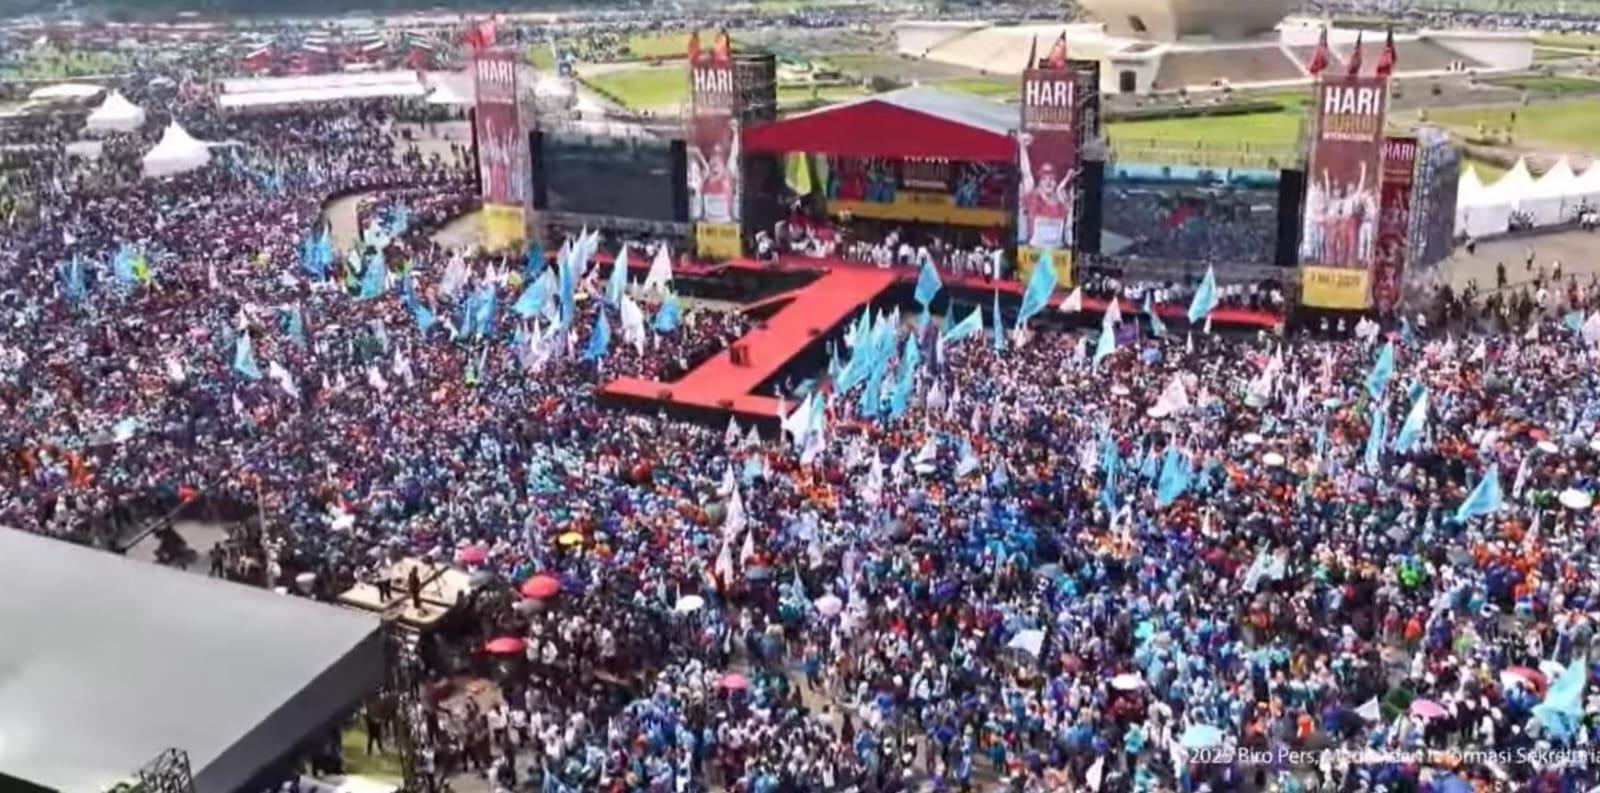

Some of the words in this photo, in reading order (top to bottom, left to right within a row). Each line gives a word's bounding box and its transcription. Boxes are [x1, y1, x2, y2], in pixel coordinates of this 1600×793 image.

[478, 60, 513, 82] HARI
[694, 68, 733, 92] HARI
[1026, 80, 1074, 107] HARI
[1324, 86, 1381, 115] HARI
[1383, 142, 1414, 160] HARI
